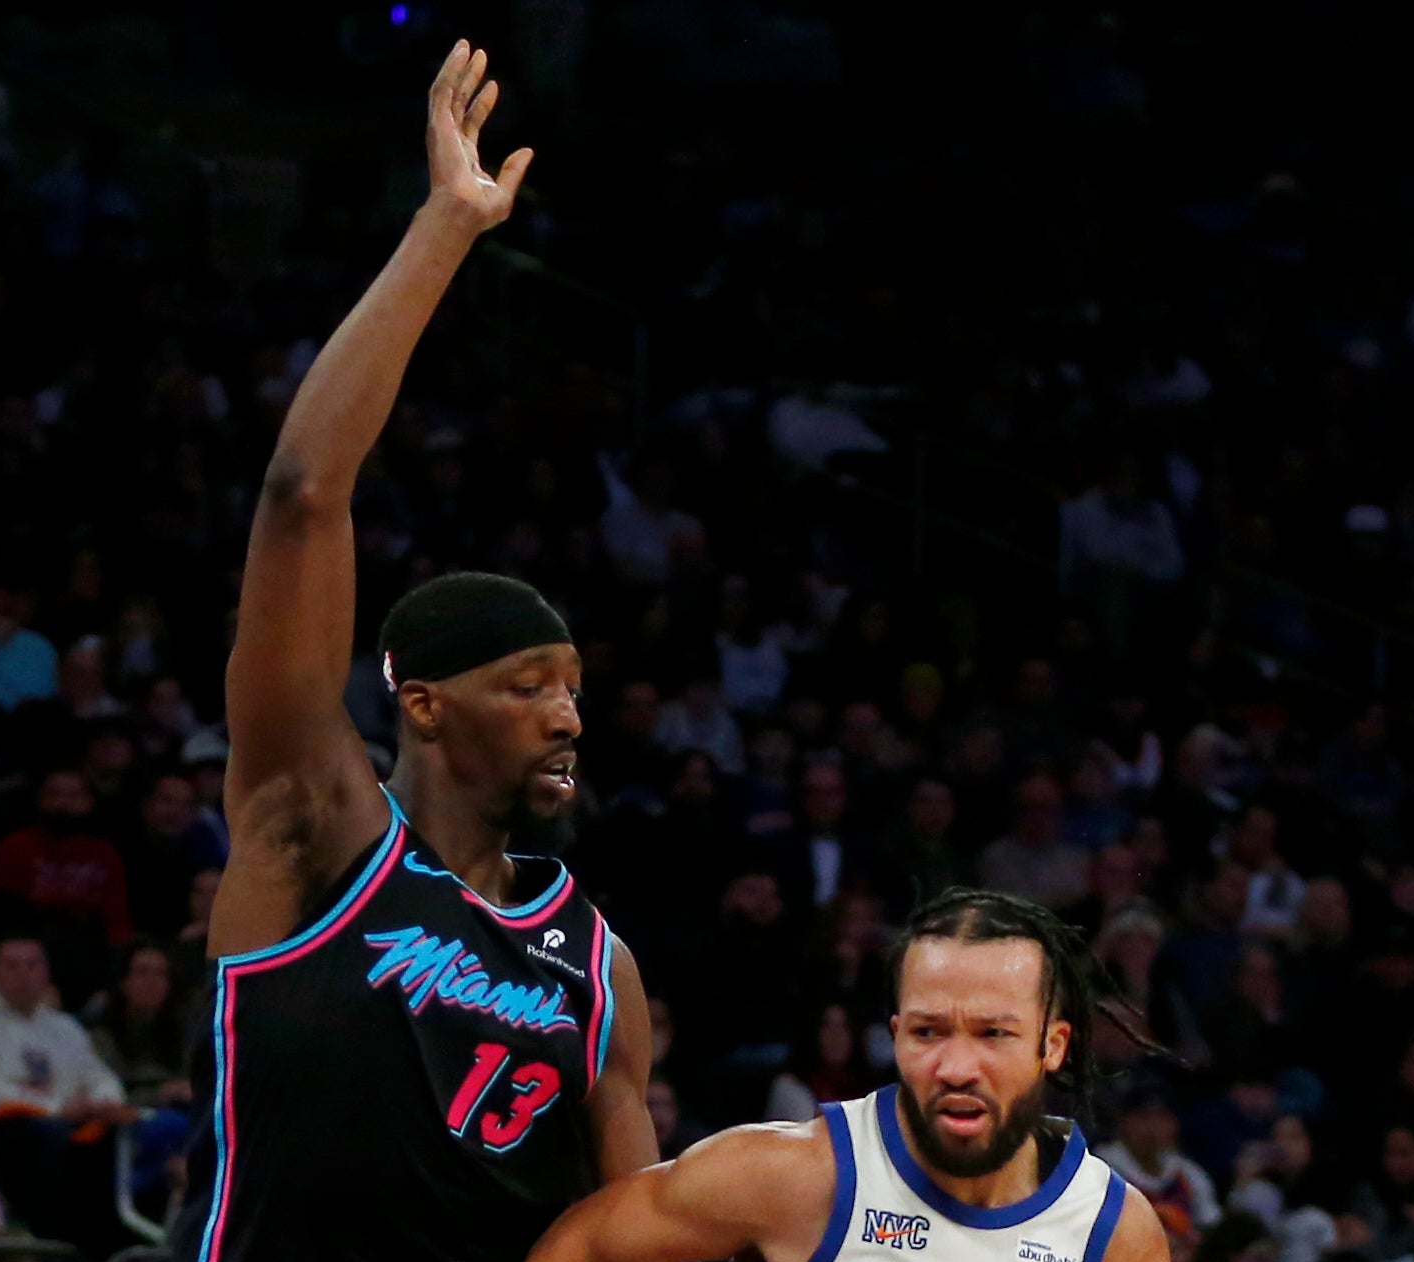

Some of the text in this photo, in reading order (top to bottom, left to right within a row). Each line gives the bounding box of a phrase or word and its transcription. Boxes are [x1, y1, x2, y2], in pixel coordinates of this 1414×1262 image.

[364, 925, 578, 1034] Miami
[527, 944, 585, 978] Robinhood
[446, 1042, 561, 1153] 13
[862, 1208, 930, 1250] NYC
[1018, 1248, 1041, 1261] abu
